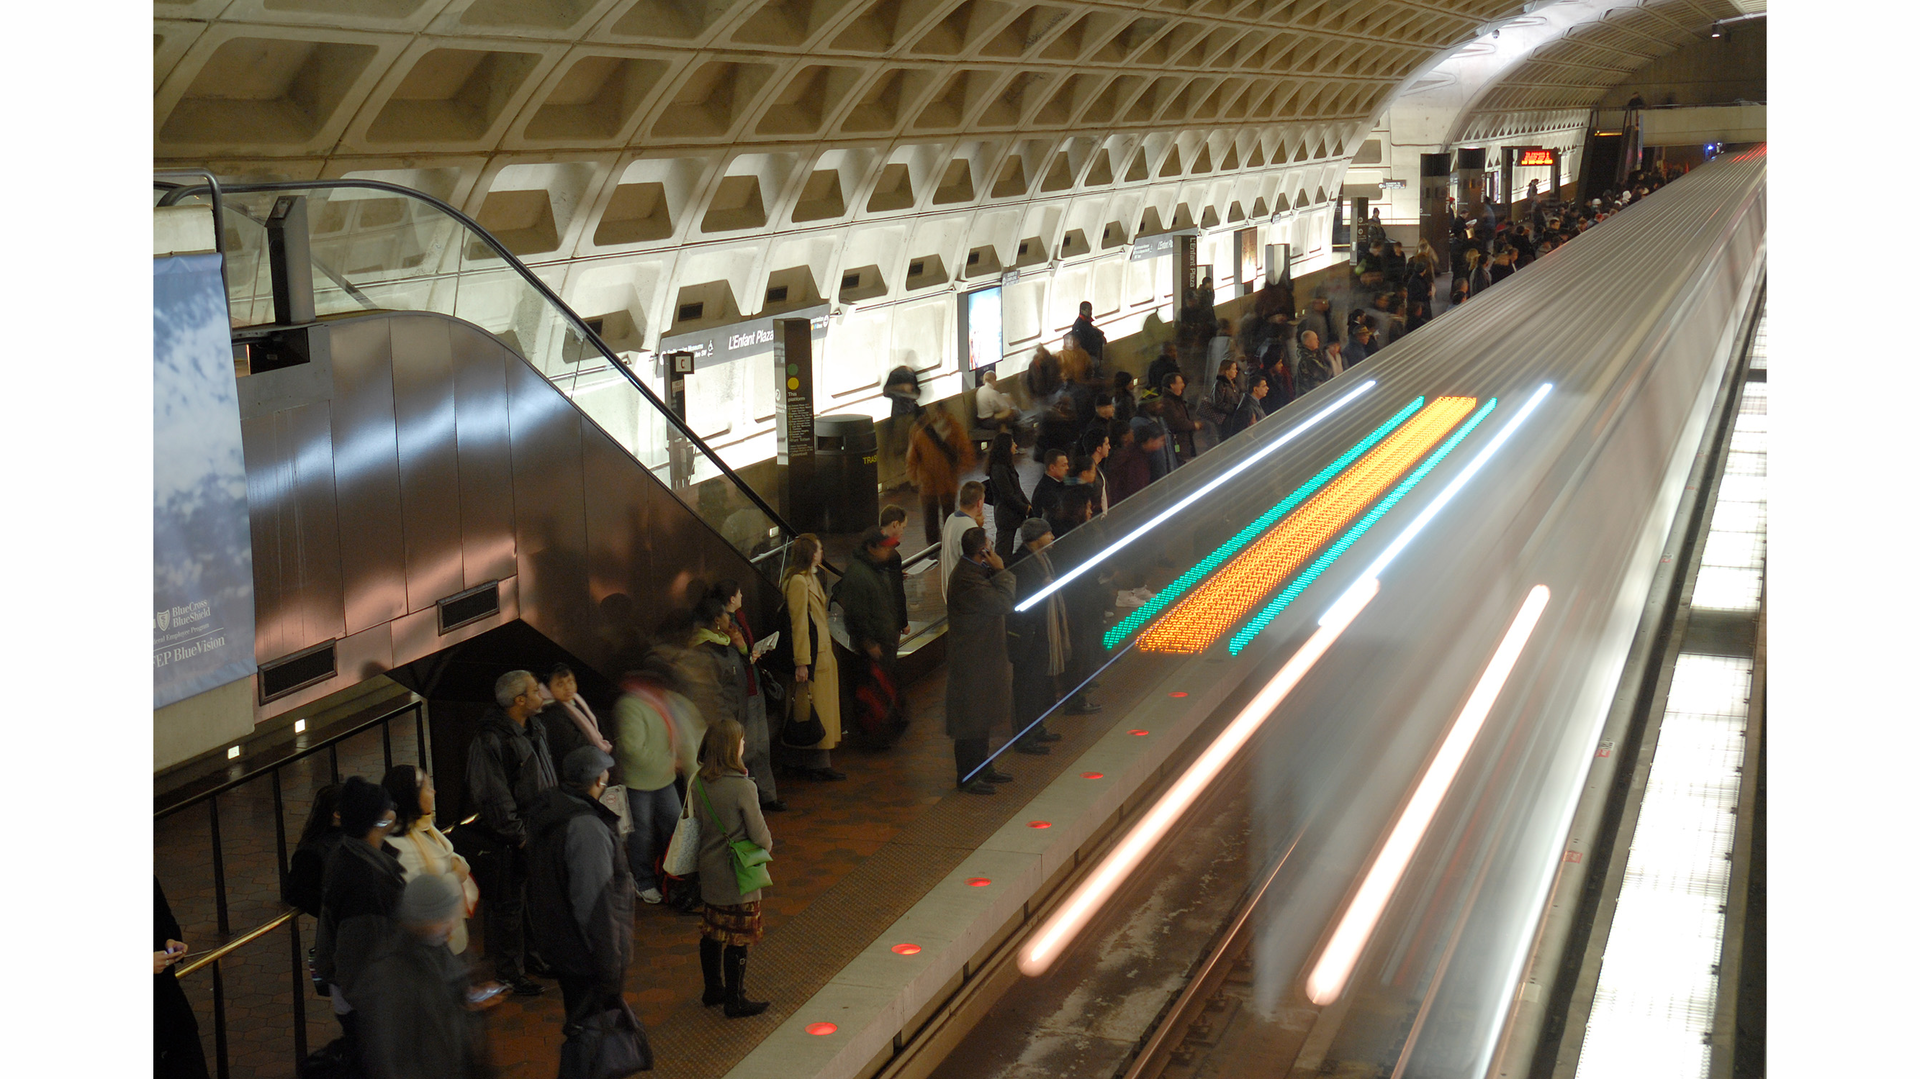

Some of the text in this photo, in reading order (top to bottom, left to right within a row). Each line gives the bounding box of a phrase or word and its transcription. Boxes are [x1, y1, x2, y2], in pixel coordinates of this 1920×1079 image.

[728, 329, 774, 350] L'Enfant Plaza
[172, 600, 208, 618] BlueCross
[173, 606, 211, 628] BlueShield
[173, 636, 226, 662] BlueVision
